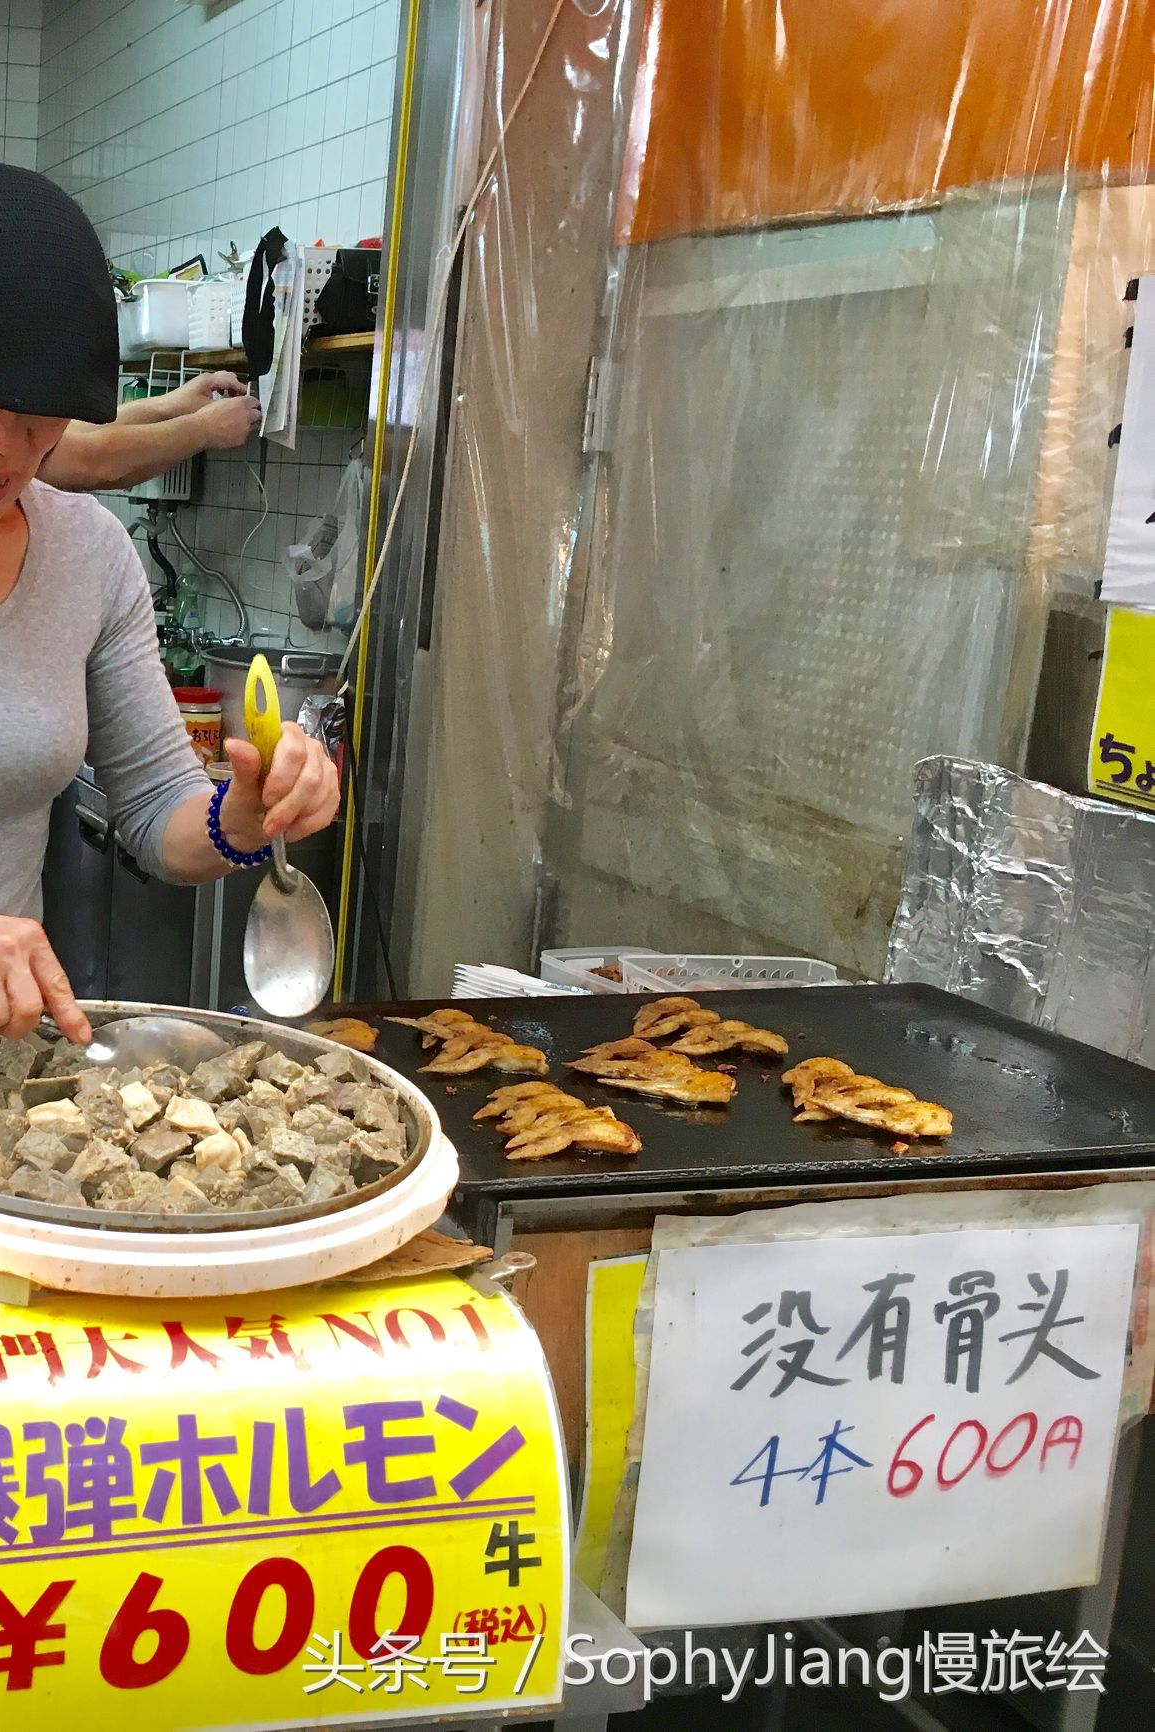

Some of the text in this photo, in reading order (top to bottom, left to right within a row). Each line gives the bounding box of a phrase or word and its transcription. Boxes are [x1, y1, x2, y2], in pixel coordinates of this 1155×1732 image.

[730, 1268, 1102, 1397] 没有骨头
[484, 1520, 542, 1587] 牛
